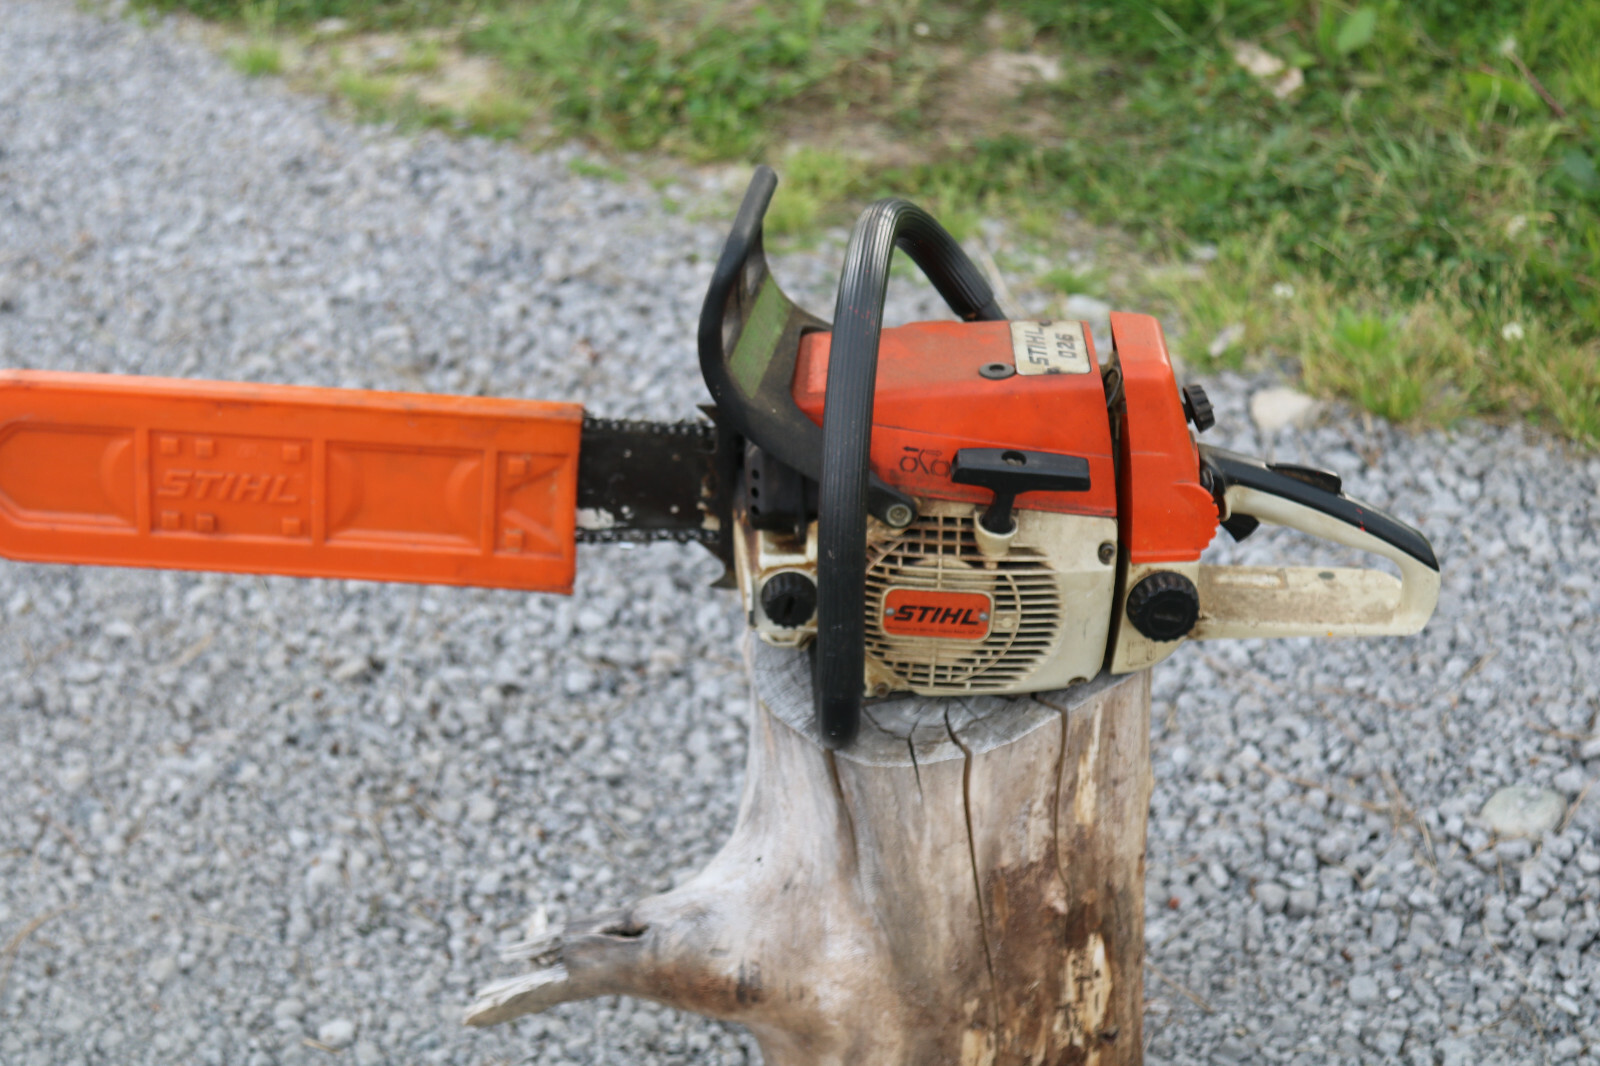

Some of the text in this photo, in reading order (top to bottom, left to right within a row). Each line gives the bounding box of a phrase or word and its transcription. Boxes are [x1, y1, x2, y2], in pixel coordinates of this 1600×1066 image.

[1024, 327, 1049, 366] STIHL
[1055, 332, 1077, 359] 026
[157, 468, 297, 504] STIHL
[894, 604, 979, 625] STIHL
